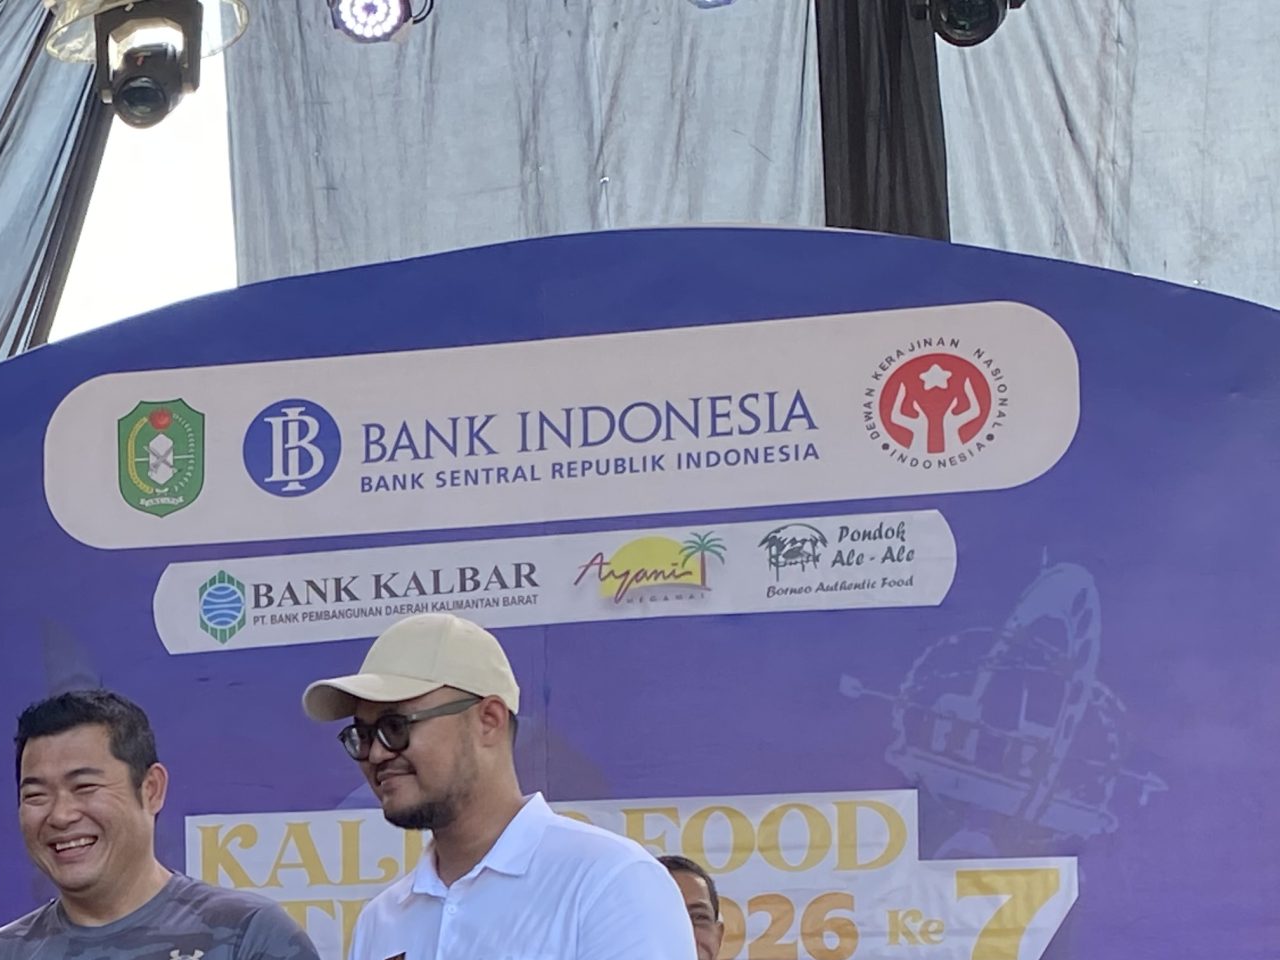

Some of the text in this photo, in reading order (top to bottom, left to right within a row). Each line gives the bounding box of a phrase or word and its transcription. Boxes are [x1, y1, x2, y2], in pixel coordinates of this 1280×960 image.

[863, 337, 1009, 441] DEWAN KERAJINAN NASIONAL
[360, 389, 819, 464] BANK INDONESIA
[360, 443, 820, 493] BANK SENTRAL REPUBLIK INDONESIA
[889, 441, 986, 470] INDONESIA
[837, 521, 906, 543] Pondok
[573, 551, 692, 604] Ayani
[830, 548, 864, 568] Ale
[881, 545, 915, 564] Ale
[251, 562, 541, 610] BANK KALBAR
[766, 575, 914, 598] Borneo Authentic Food
[253, 594, 539, 626] PT. BANK PEMBANGUNAN DAERAH KALIMANTAN BARAT
[622, 800, 908, 875] FOOD
[886, 908, 945, 946] Ke
